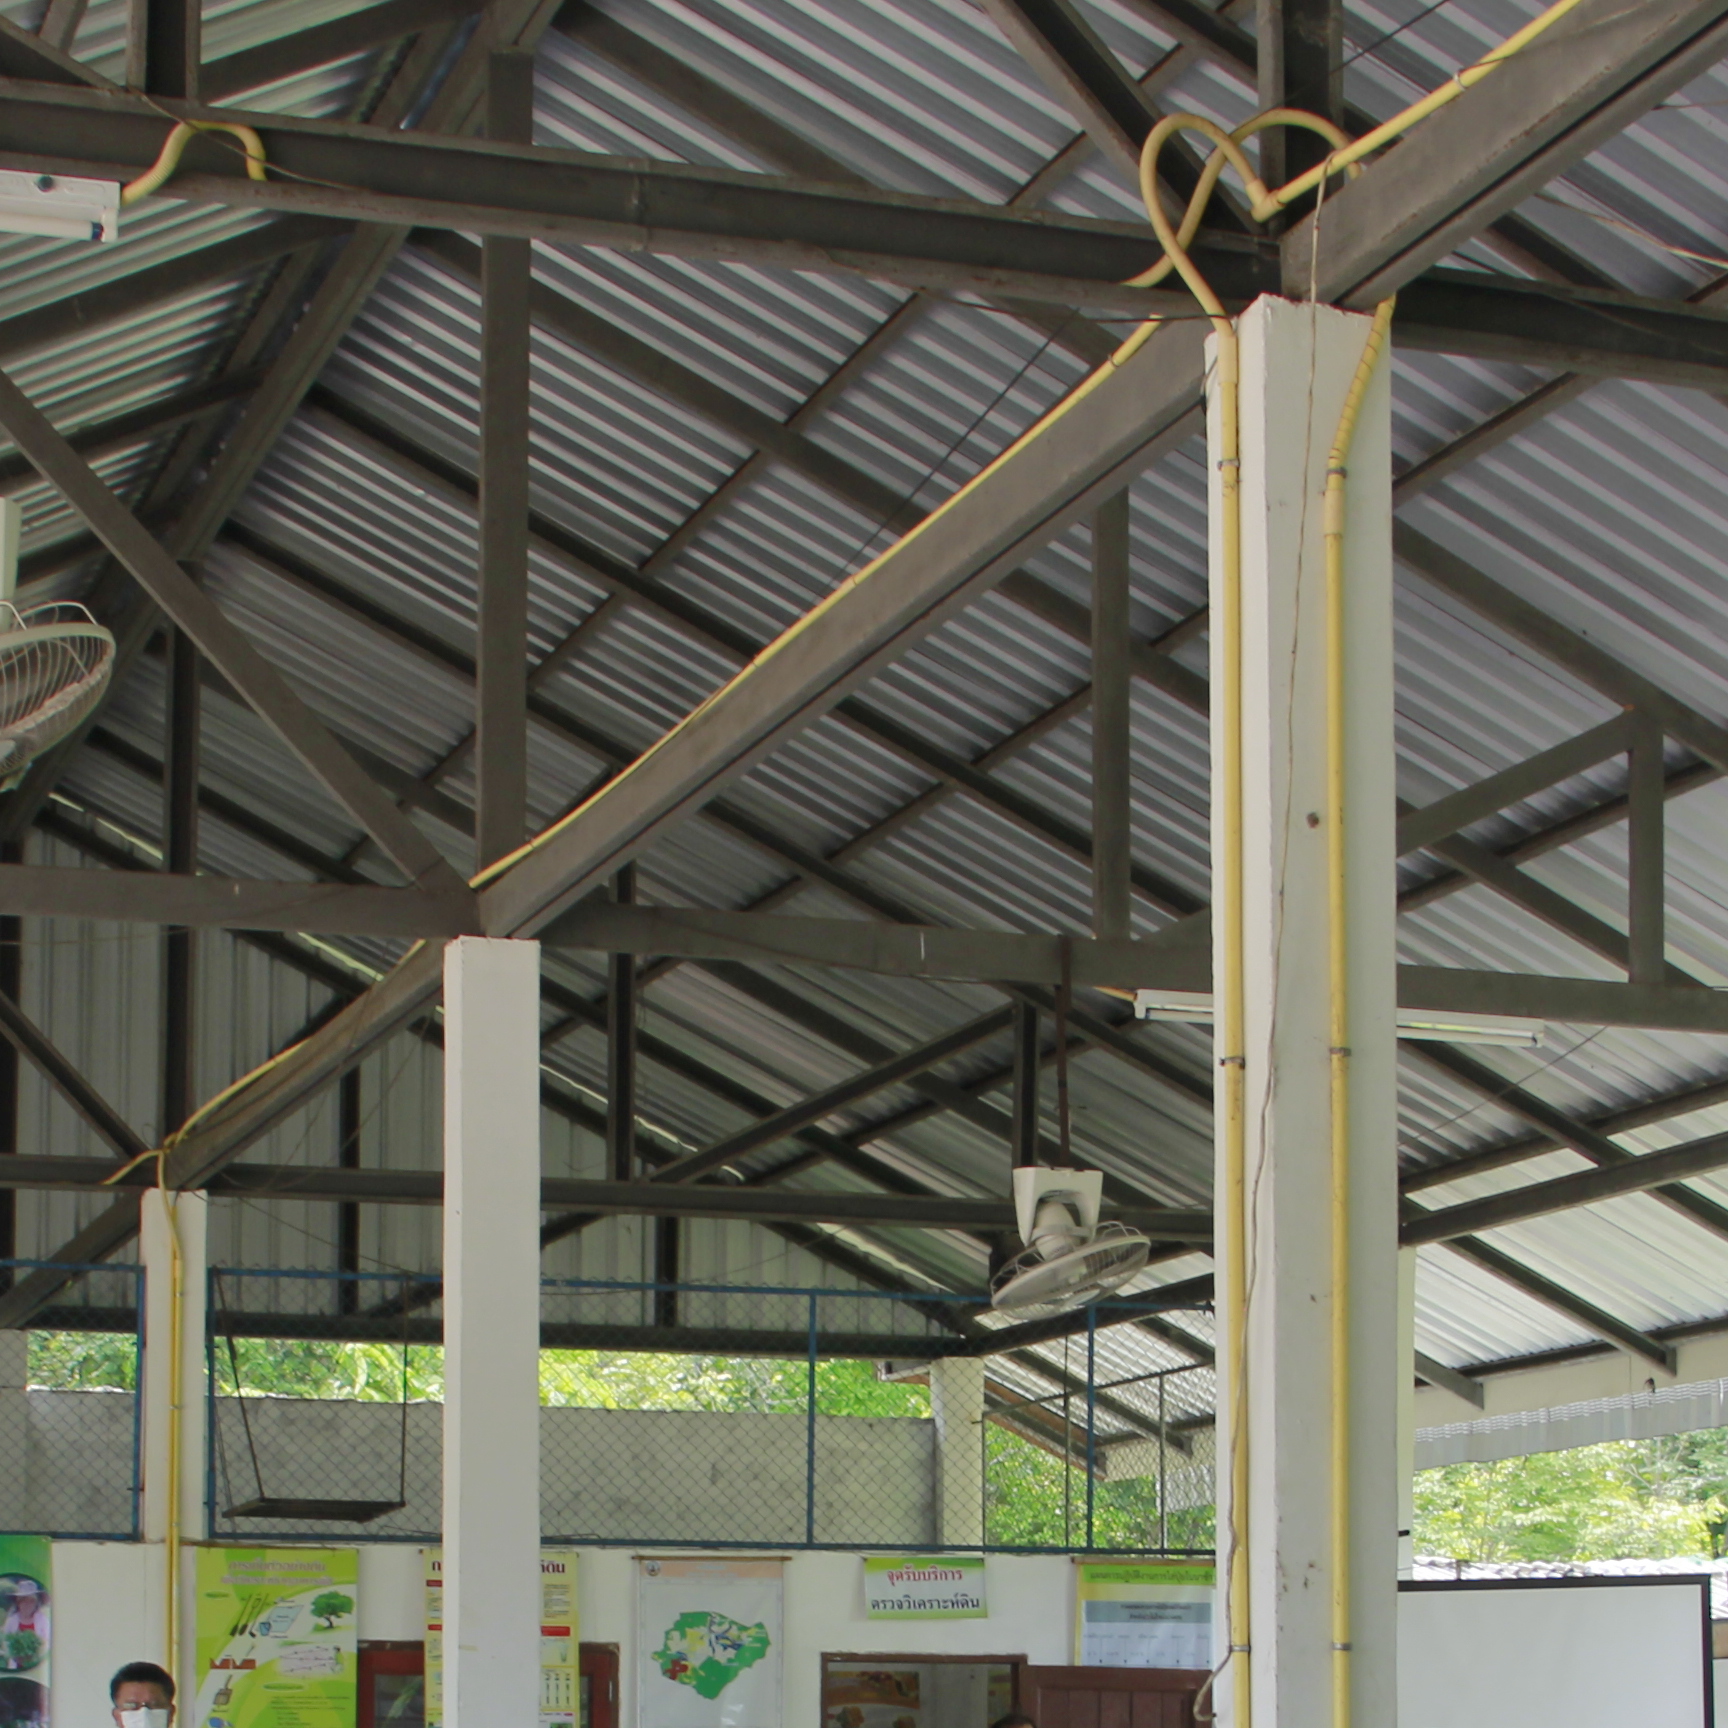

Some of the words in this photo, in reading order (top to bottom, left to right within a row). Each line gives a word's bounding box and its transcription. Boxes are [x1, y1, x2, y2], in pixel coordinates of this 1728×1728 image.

[887, 1565, 963, 1587] จุดรับบริการ
[871, 1593, 980, 1610] ตรวจวิเคราะห์ดิน
